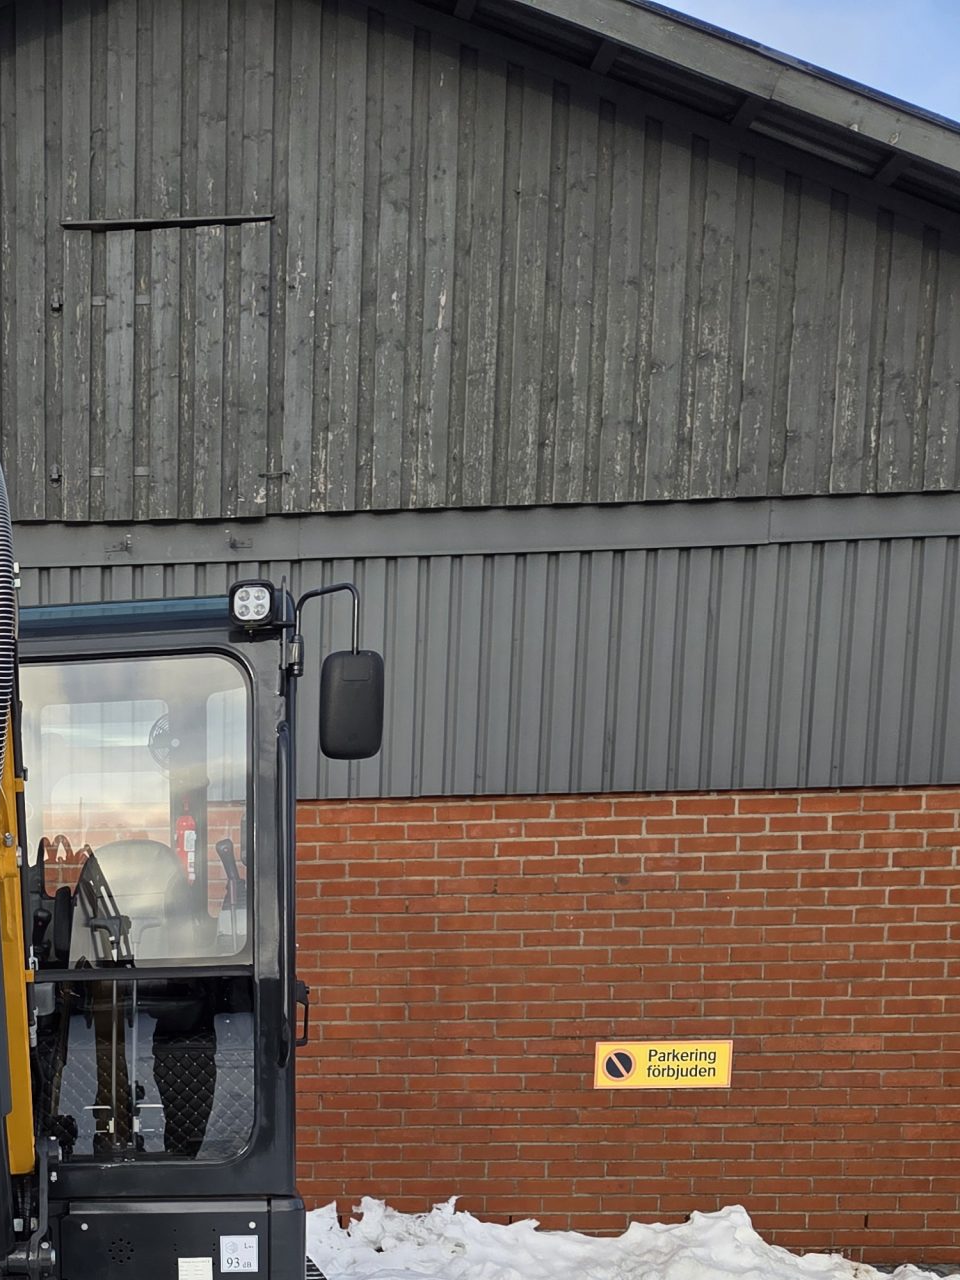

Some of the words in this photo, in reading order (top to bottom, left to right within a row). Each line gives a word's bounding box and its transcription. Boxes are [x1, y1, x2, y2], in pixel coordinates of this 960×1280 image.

[648, 1049, 717, 1064] Parkering
[646, 1065, 716, 1080] förbjuden
[226, 1257, 240, 1269] 93
